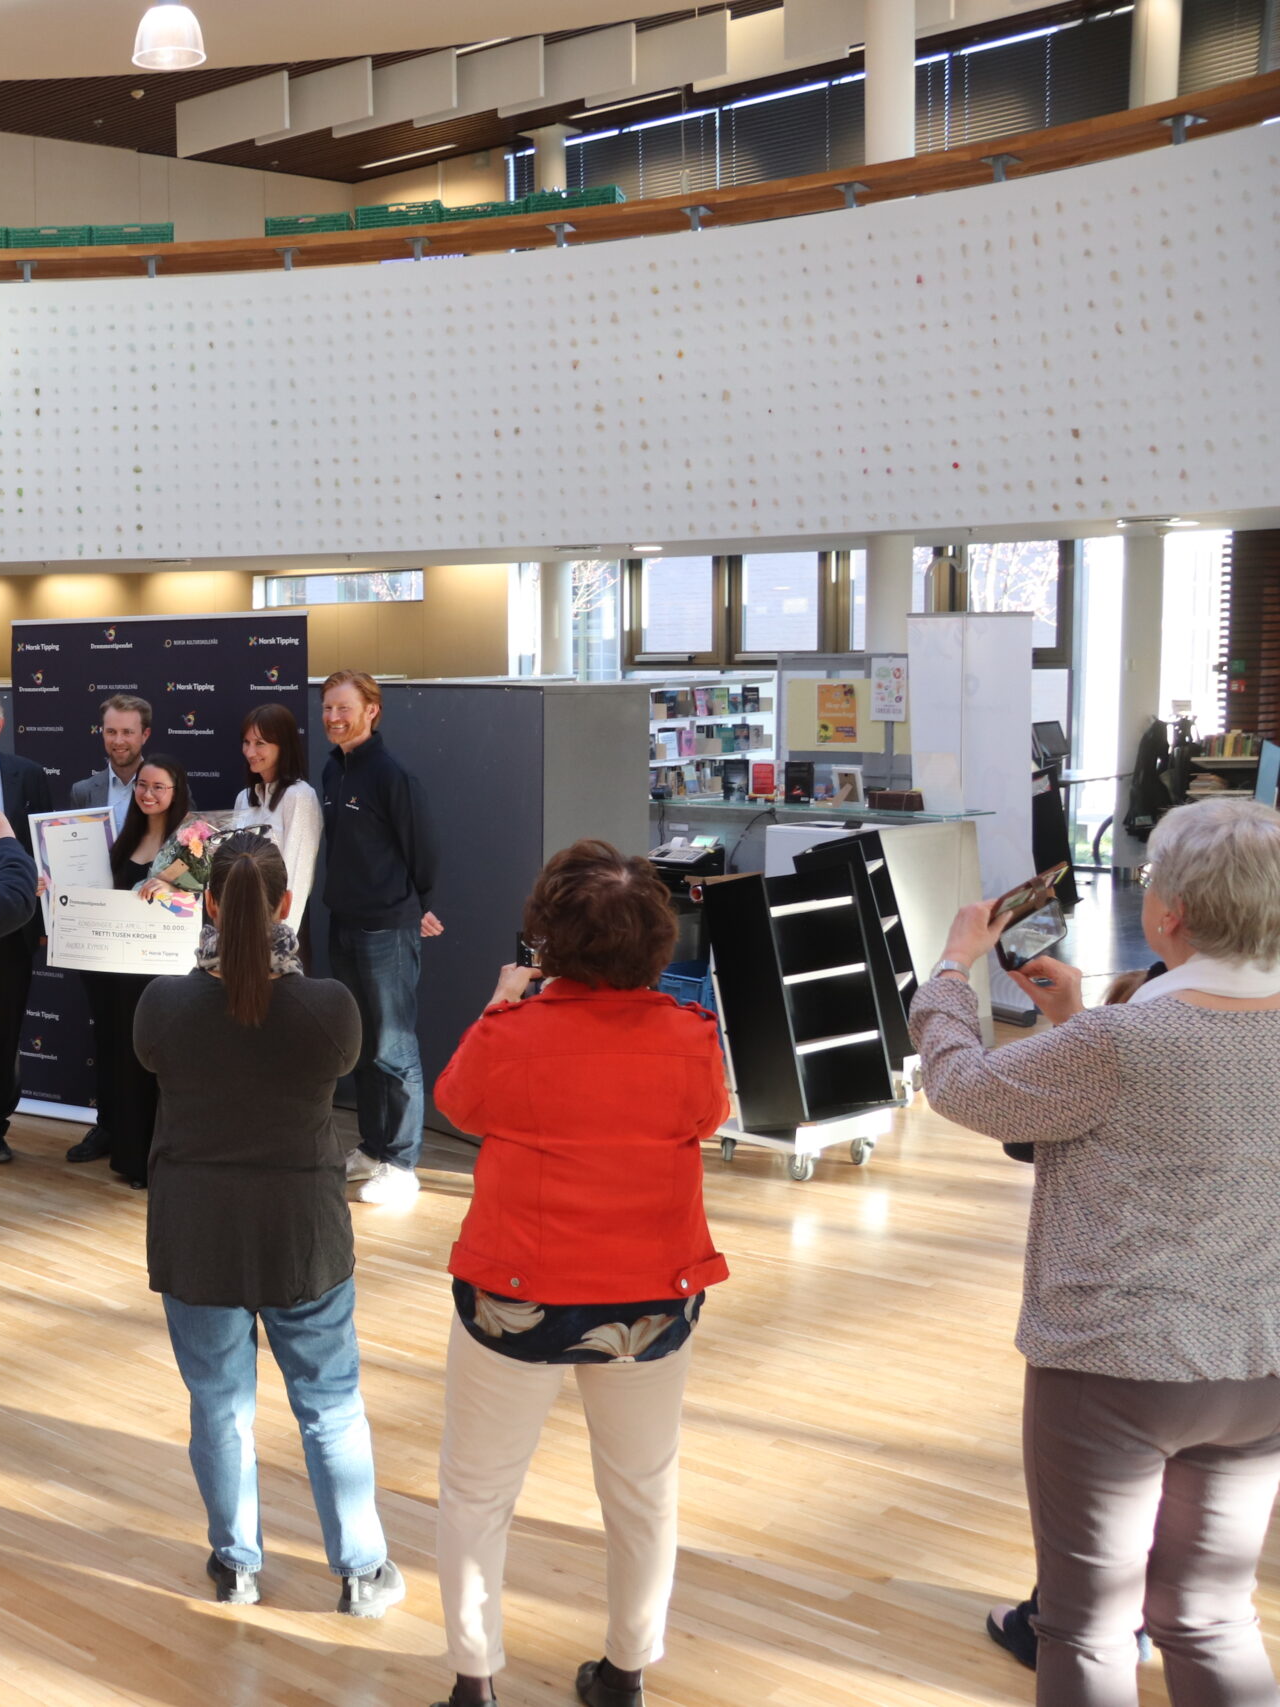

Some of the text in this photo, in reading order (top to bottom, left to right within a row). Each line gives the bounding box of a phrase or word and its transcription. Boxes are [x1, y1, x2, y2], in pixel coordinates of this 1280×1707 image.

[259, 636, 299, 646] Norsk Tipping
[25, 643, 60, 652] Norsk Tipping
[176, 682, 215, 692] Norsk Tipping
[112, 931, 131, 939] TUSEN
